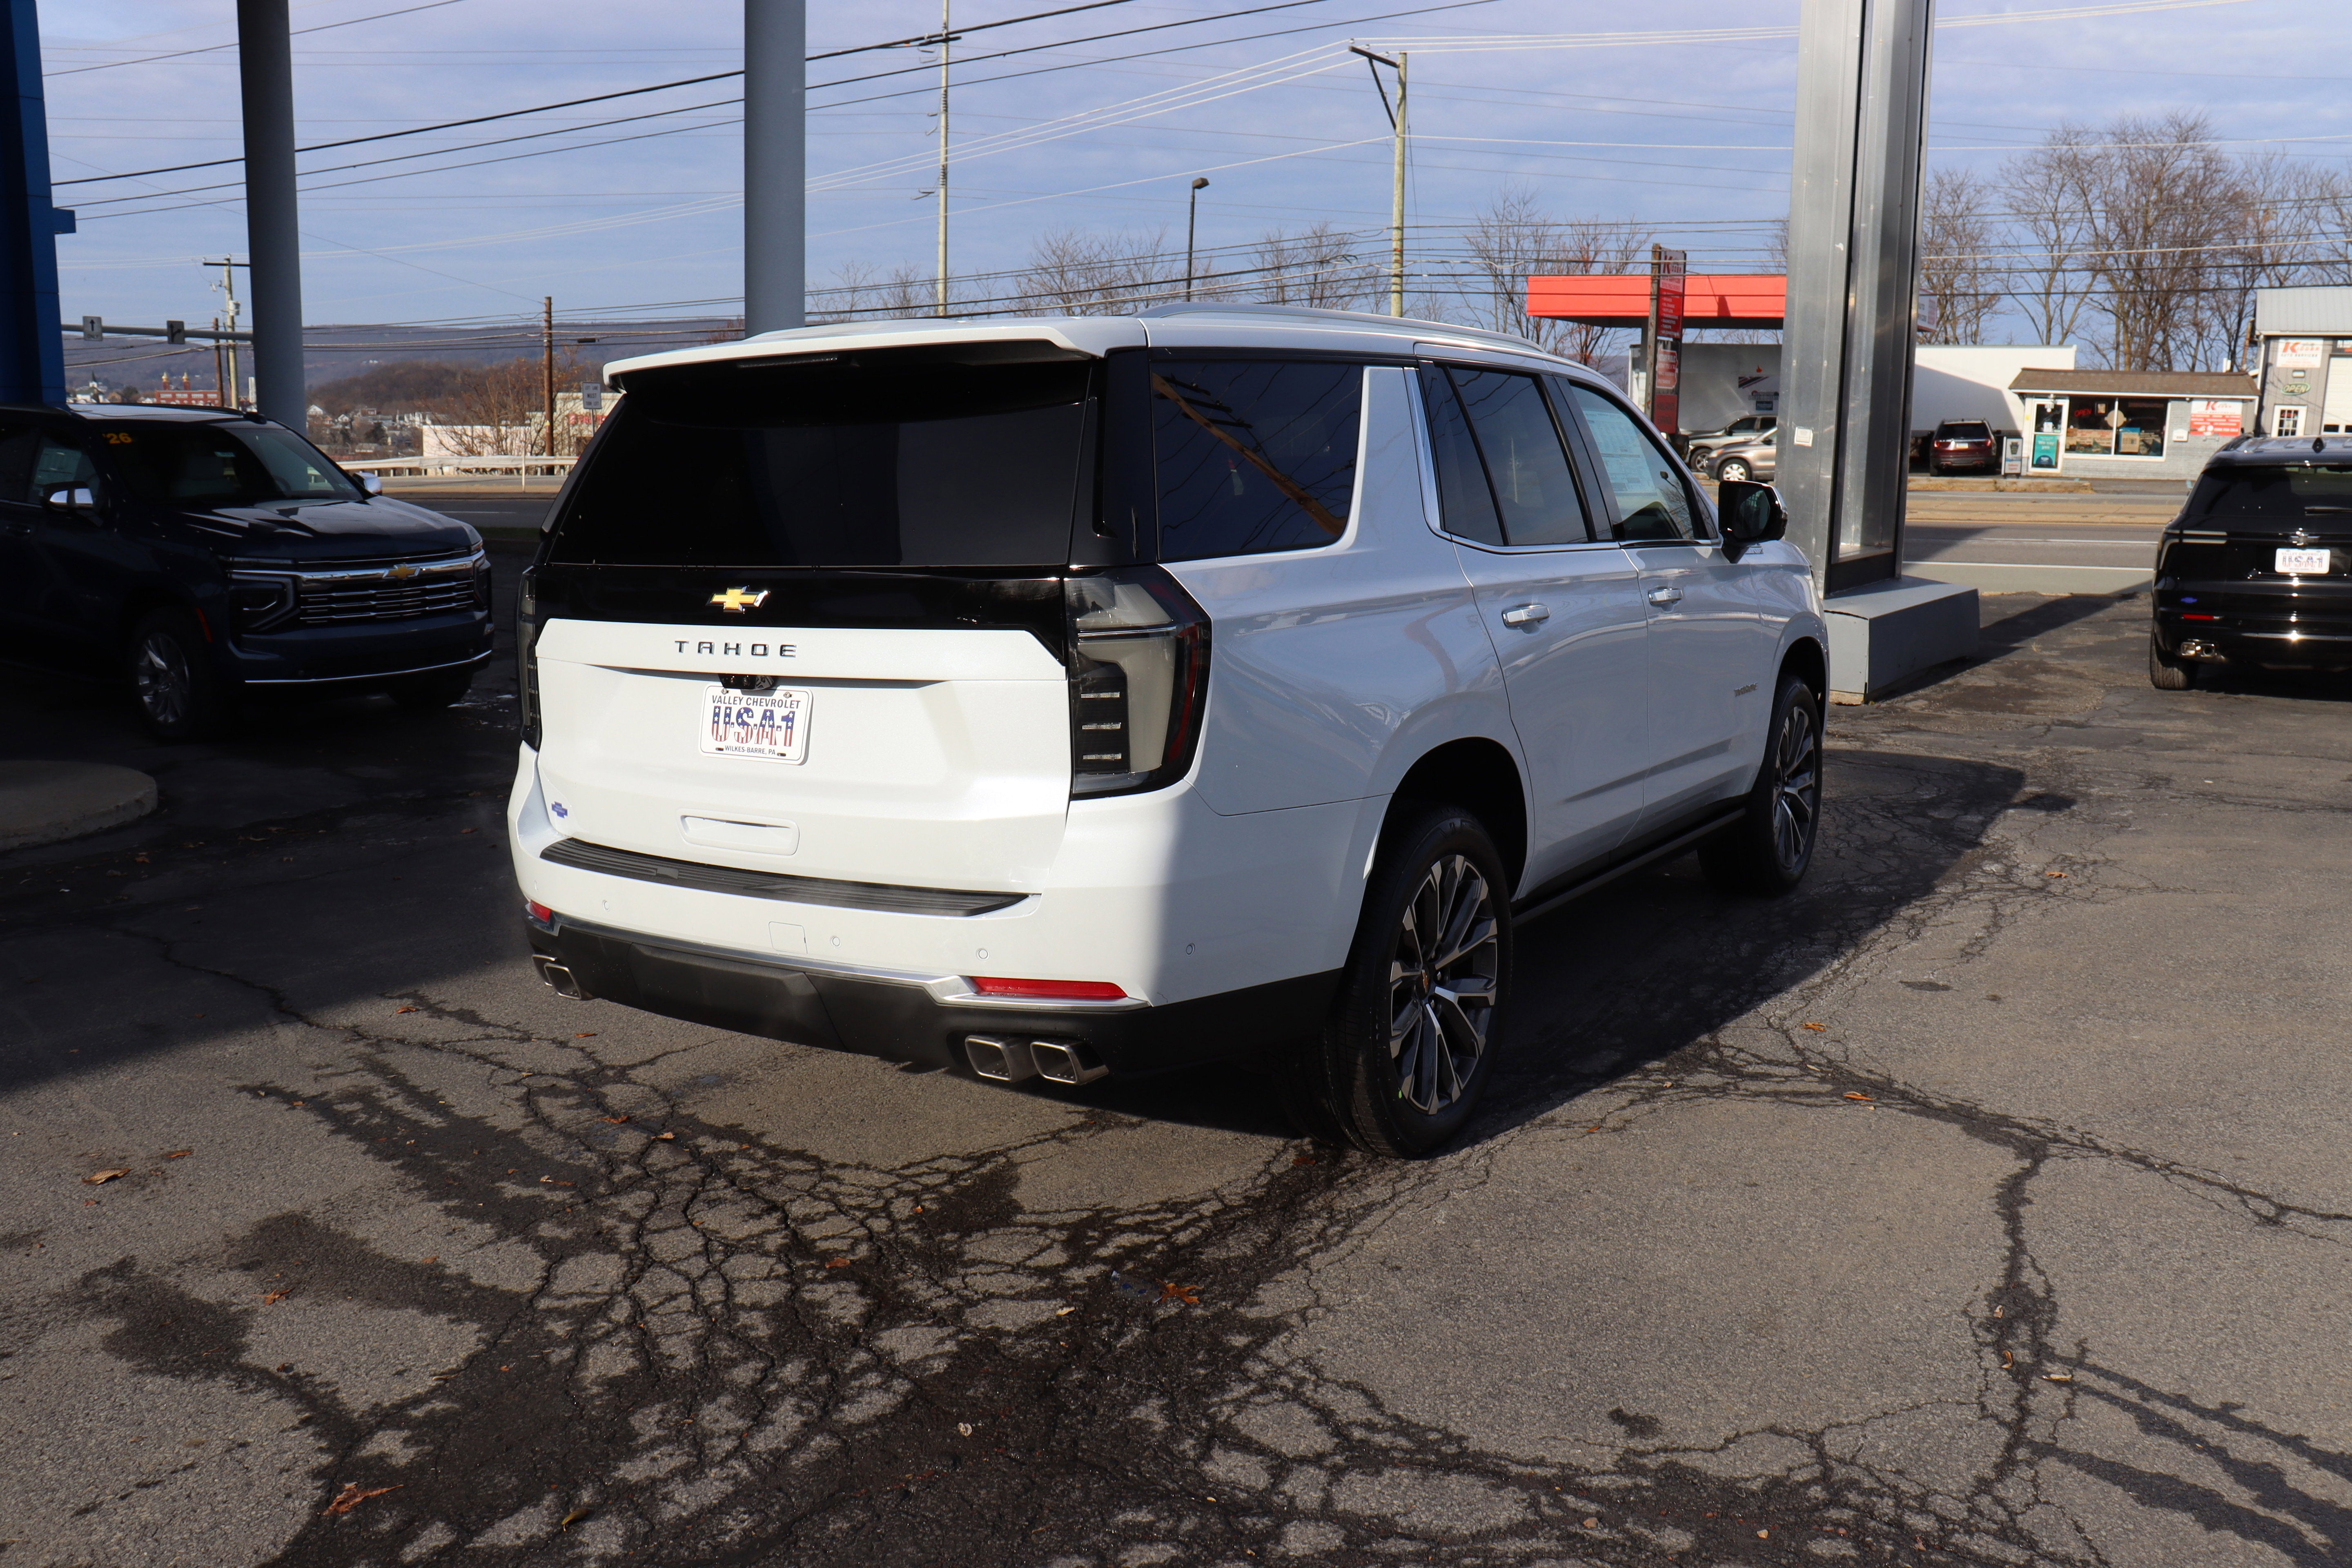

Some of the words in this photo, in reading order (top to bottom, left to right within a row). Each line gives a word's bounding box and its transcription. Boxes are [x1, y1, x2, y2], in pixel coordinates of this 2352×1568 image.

[2283, 384, 2307, 393] OPEN
[2074, 409, 2092, 417] OPEN
[675, 640, 797, 657] TAHOE
[712, 695, 744, 705] VALLEY
[746, 697, 801, 709] CHEVROLET
[725, 745, 767, 755] WILKES-BARRE,
